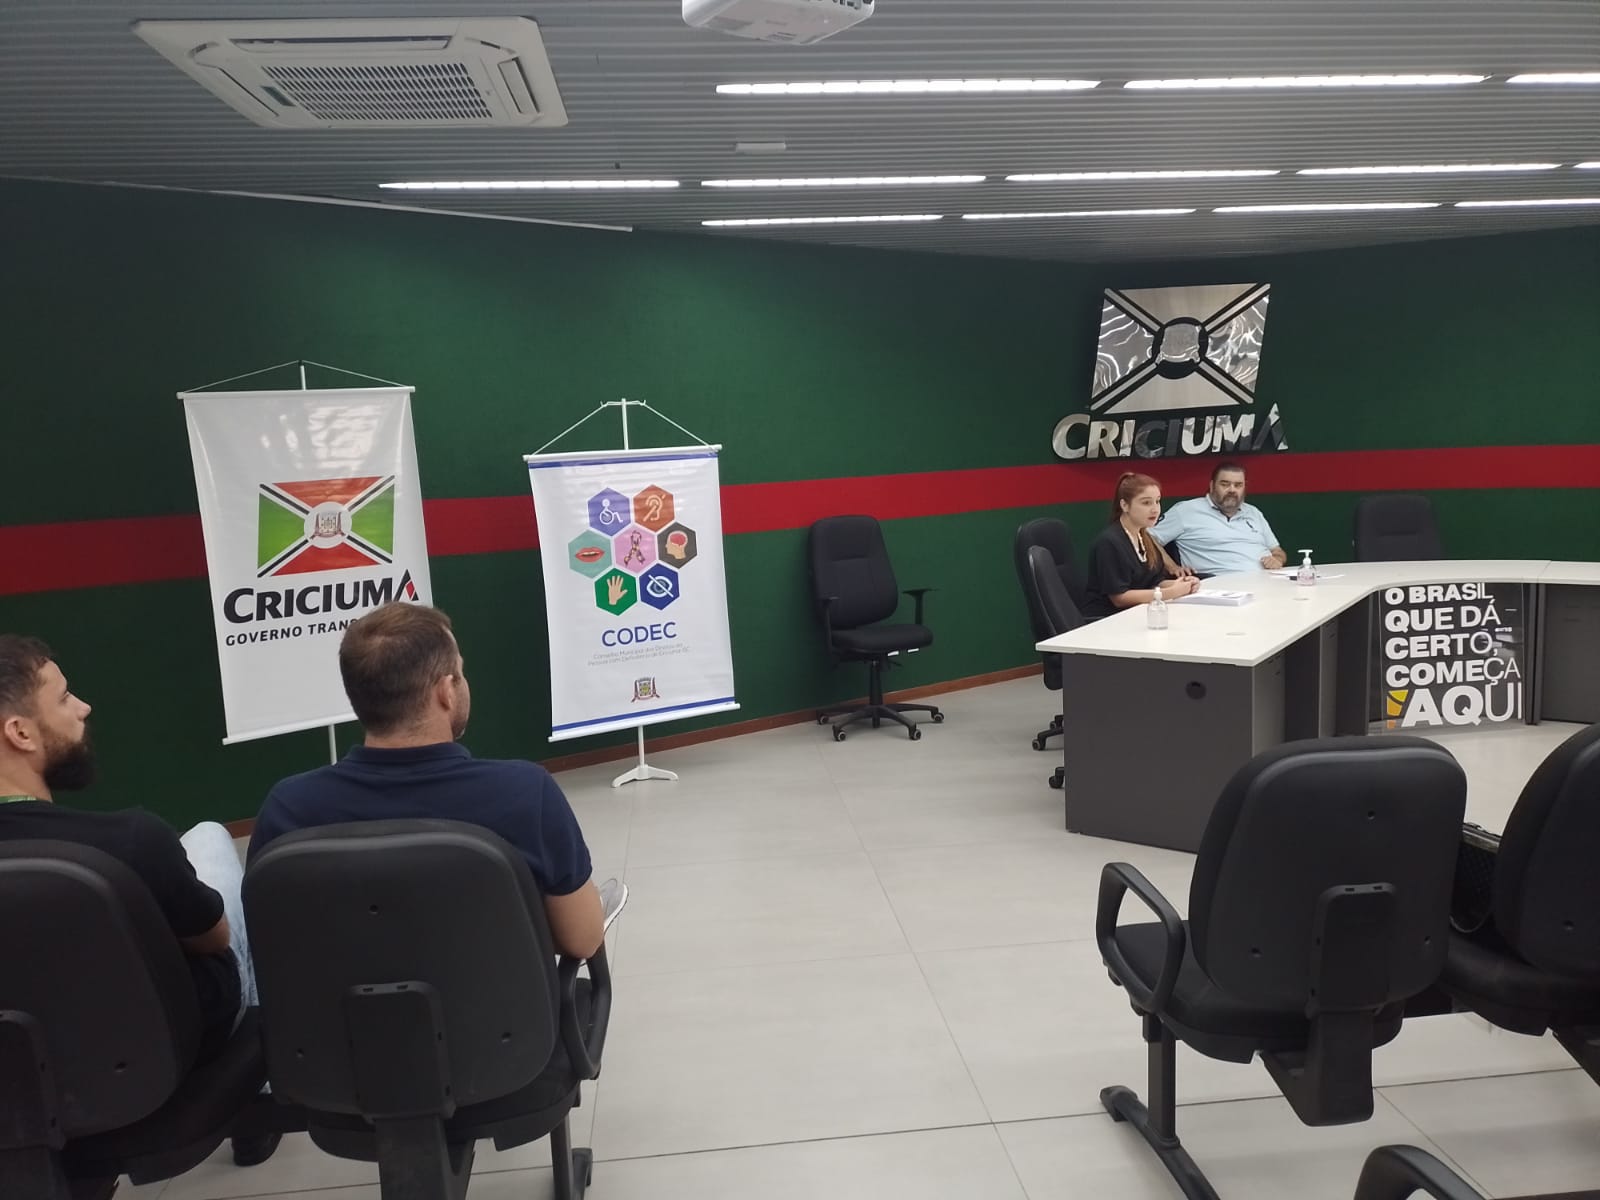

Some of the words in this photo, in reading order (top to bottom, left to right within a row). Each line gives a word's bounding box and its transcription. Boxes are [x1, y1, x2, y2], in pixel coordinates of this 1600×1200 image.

[1385, 587, 1405, 605] O
[1409, 582, 1494, 604] BRASIL
[1385, 607, 1454, 633] QUE
[1460, 599, 1501, 628] DÁ
[225, 625, 302, 646] GOVERNO
[601, 621, 677, 647] CODEC
[1385, 631, 1498, 660] CERTO,
[1385, 657, 1521, 688] COMEÇA
[1401, 682, 1522, 728] AQUI
